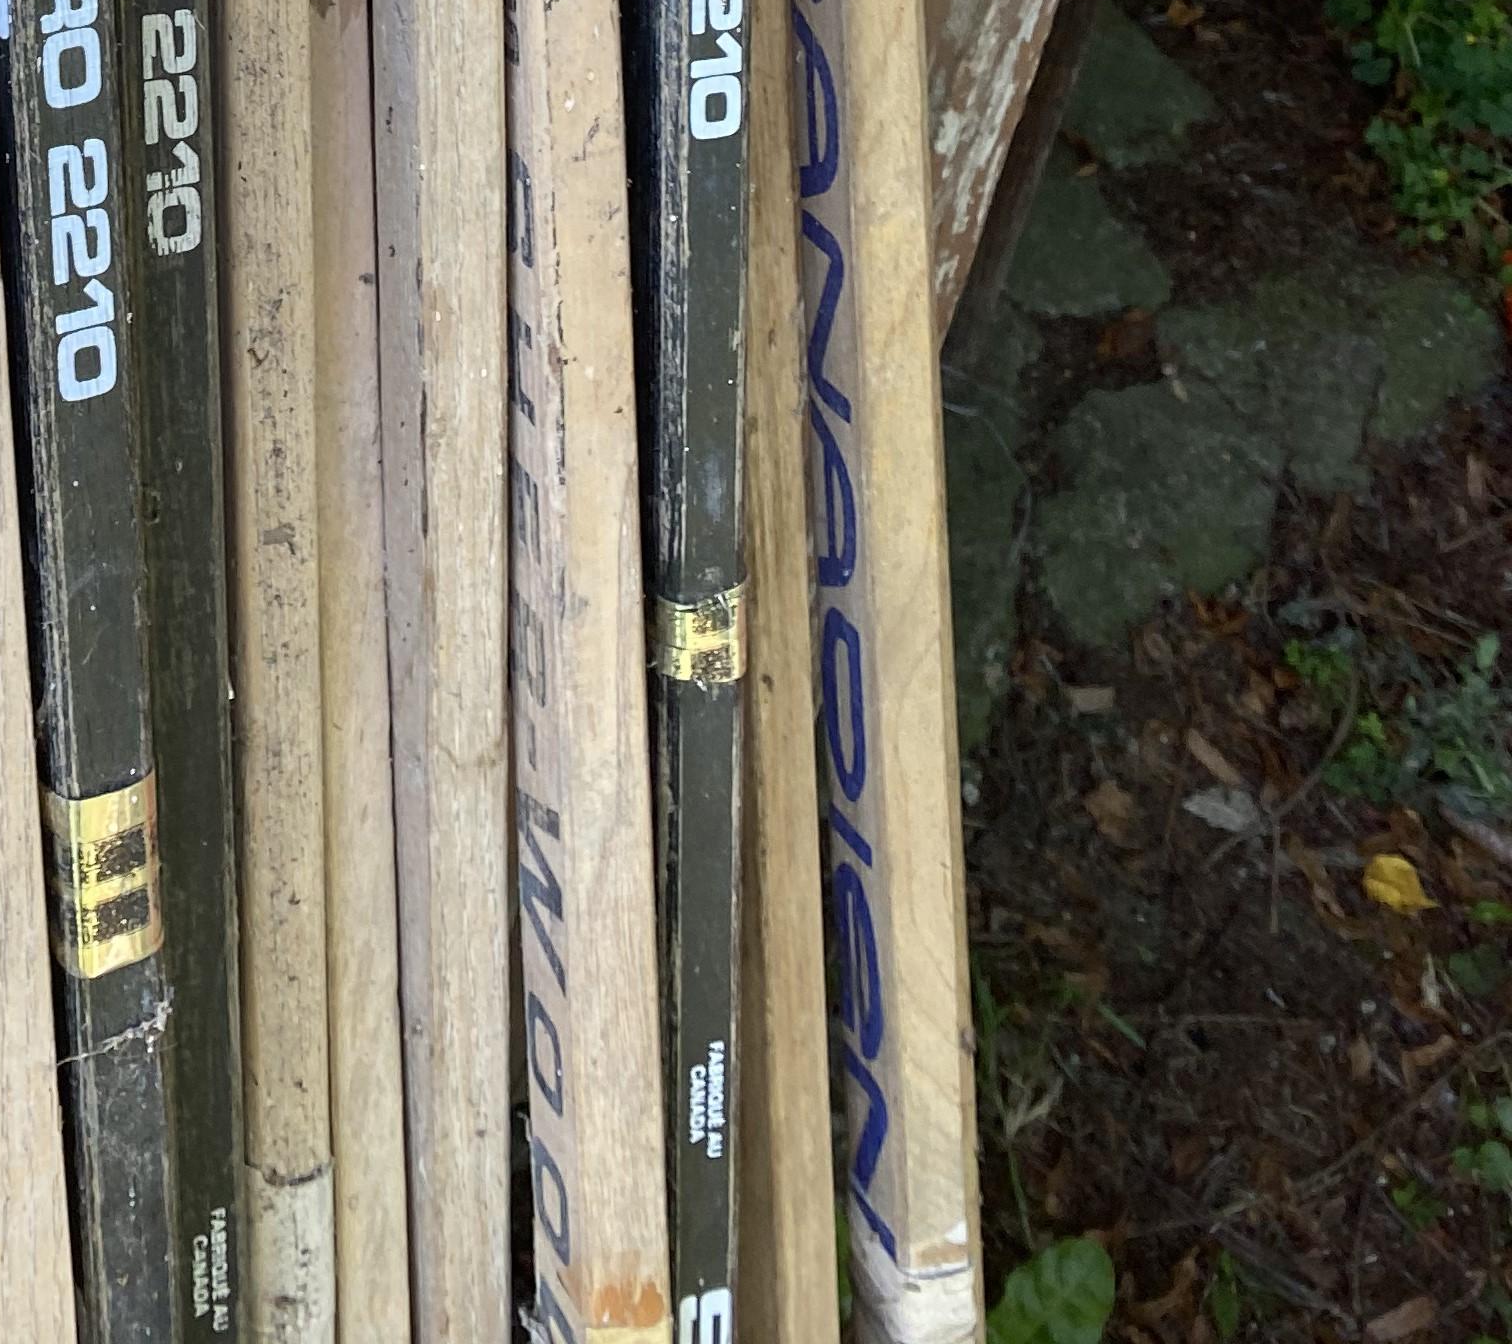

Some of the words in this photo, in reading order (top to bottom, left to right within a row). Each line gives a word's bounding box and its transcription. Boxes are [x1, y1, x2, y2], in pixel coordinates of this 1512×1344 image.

[140, 7, 202, 256] 2210
[47, 137, 119, 403] 2210
[689, 1063, 707, 1144] CANADA
[706, 1131, 725, 1158] AU
[192, 1234, 210, 1319] CANADA
[211, 1303, 230, 1332] AU
